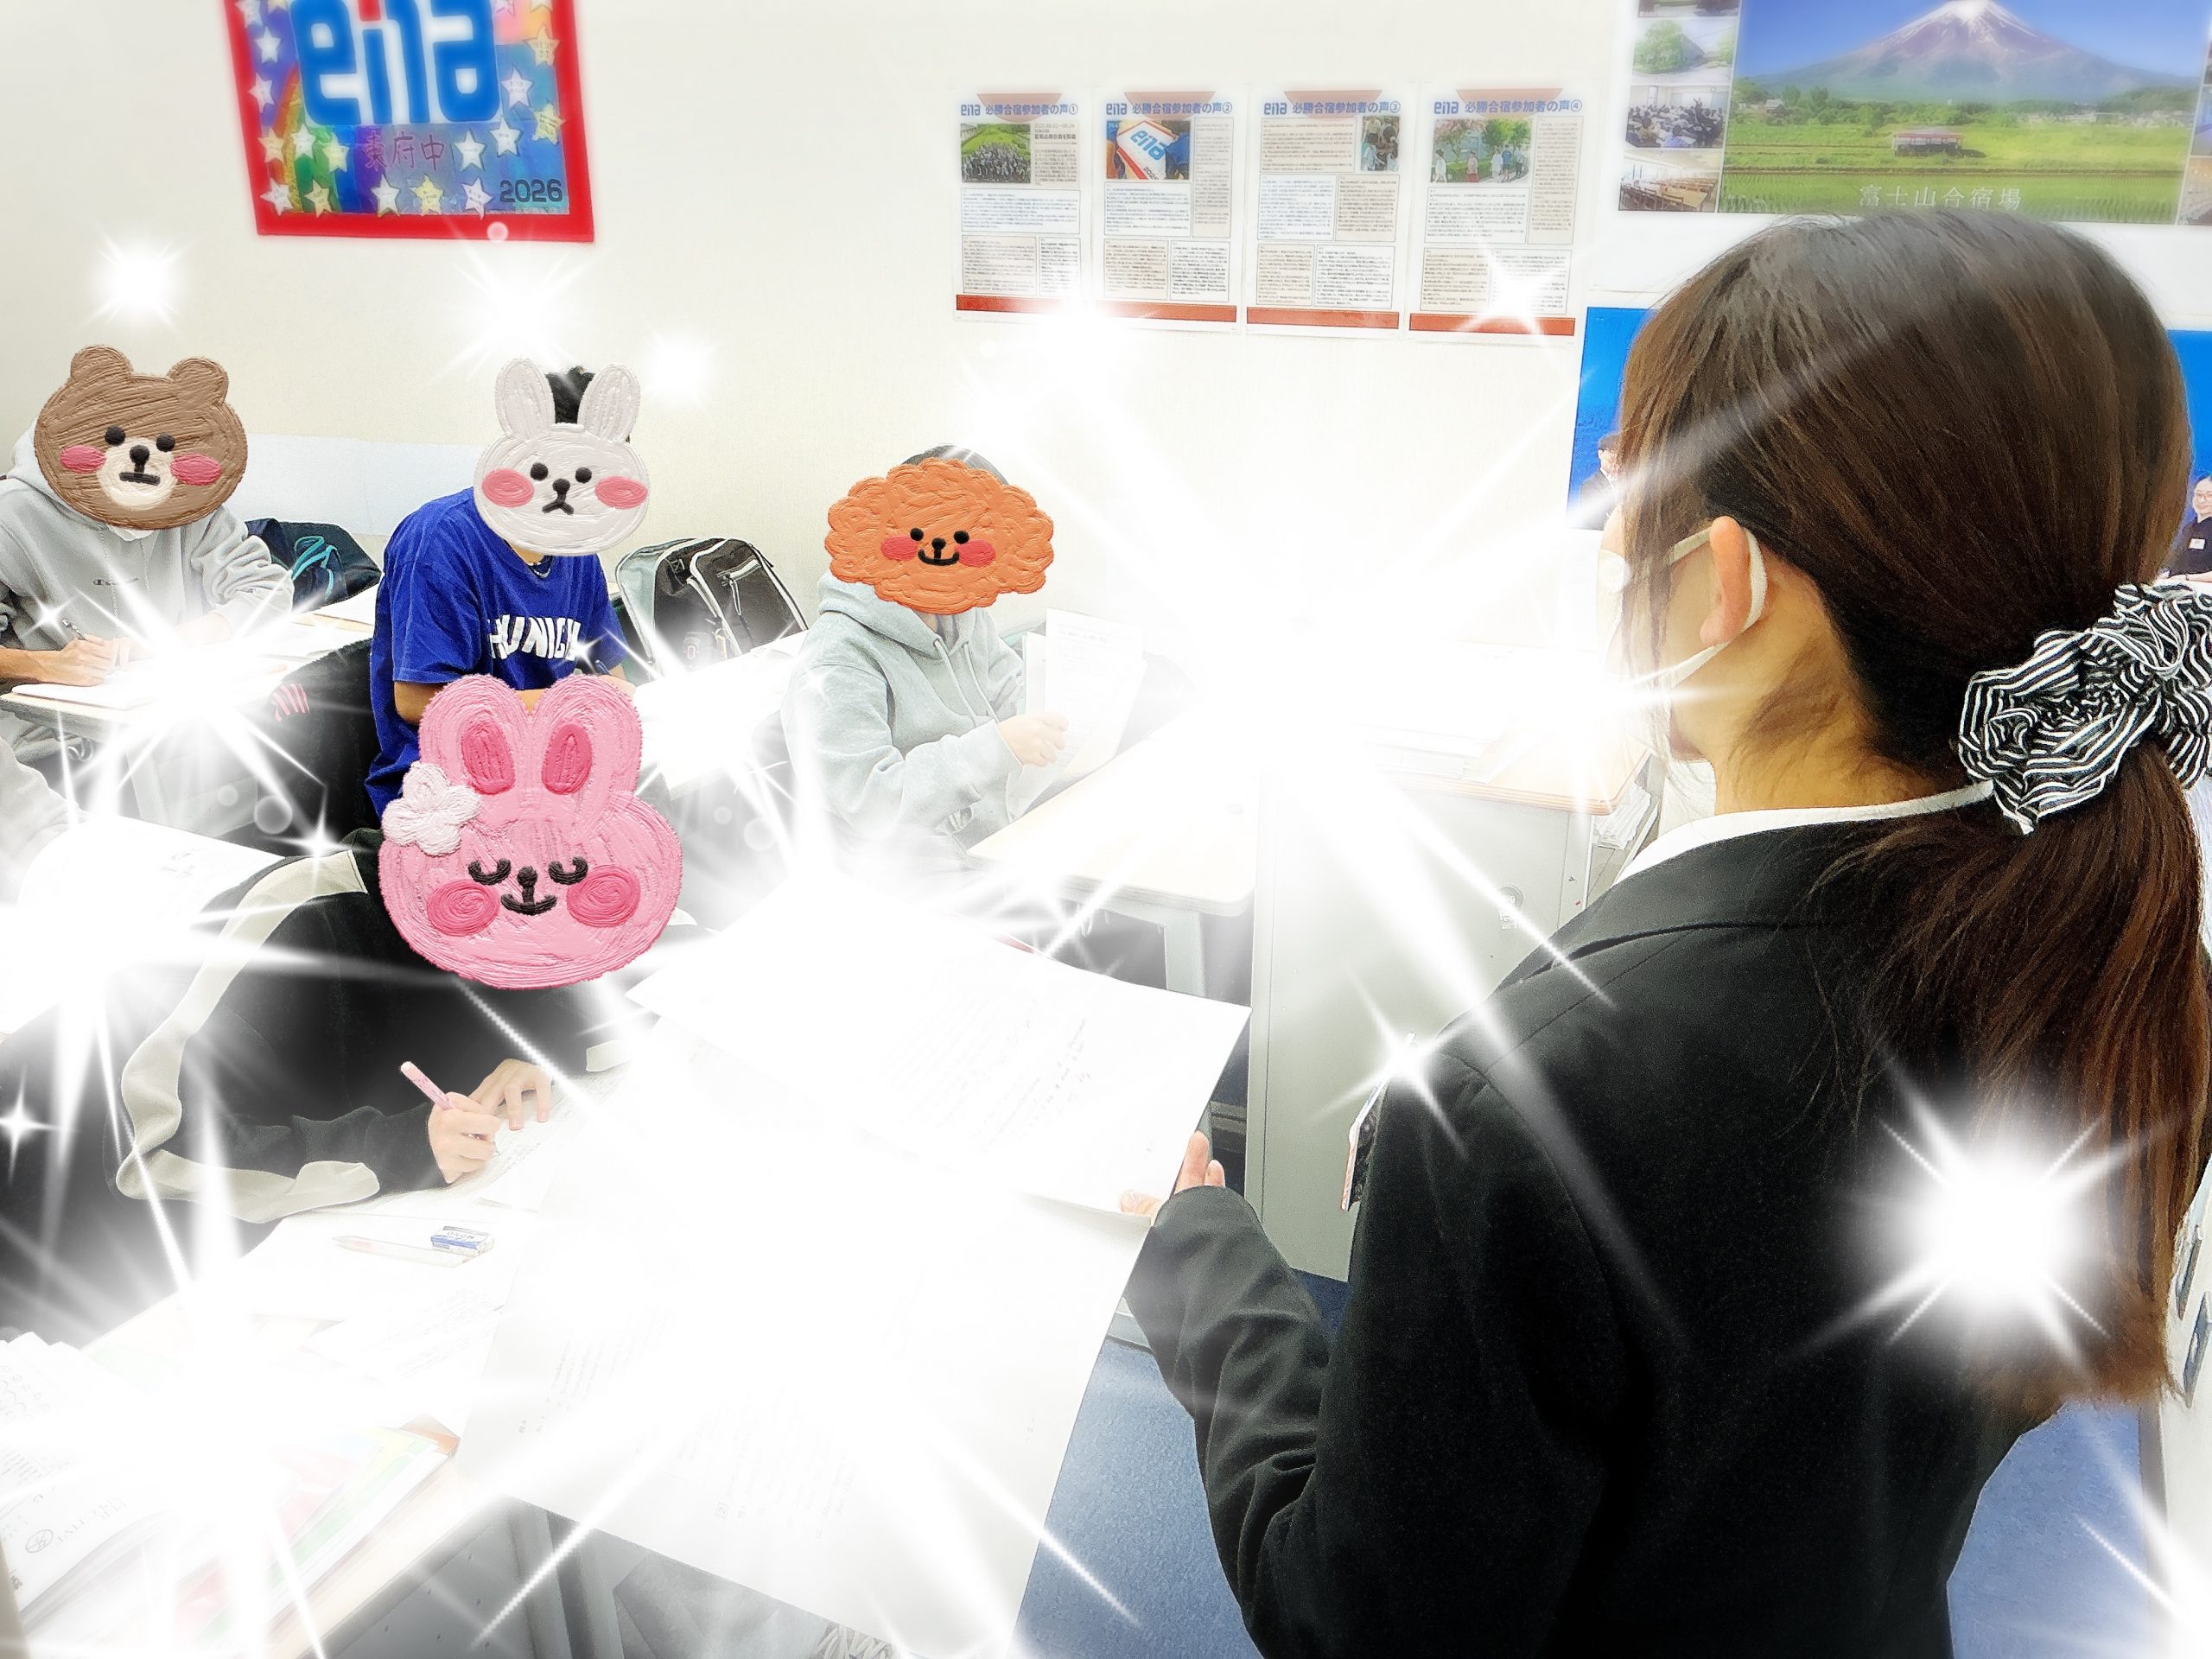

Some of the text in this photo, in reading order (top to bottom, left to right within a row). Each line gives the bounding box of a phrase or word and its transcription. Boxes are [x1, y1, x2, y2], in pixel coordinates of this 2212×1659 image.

[363, 130, 445, 171] 東府中
[499, 178, 563, 204] 2026
[1859, 184, 2023, 211] 富士山合宿場
